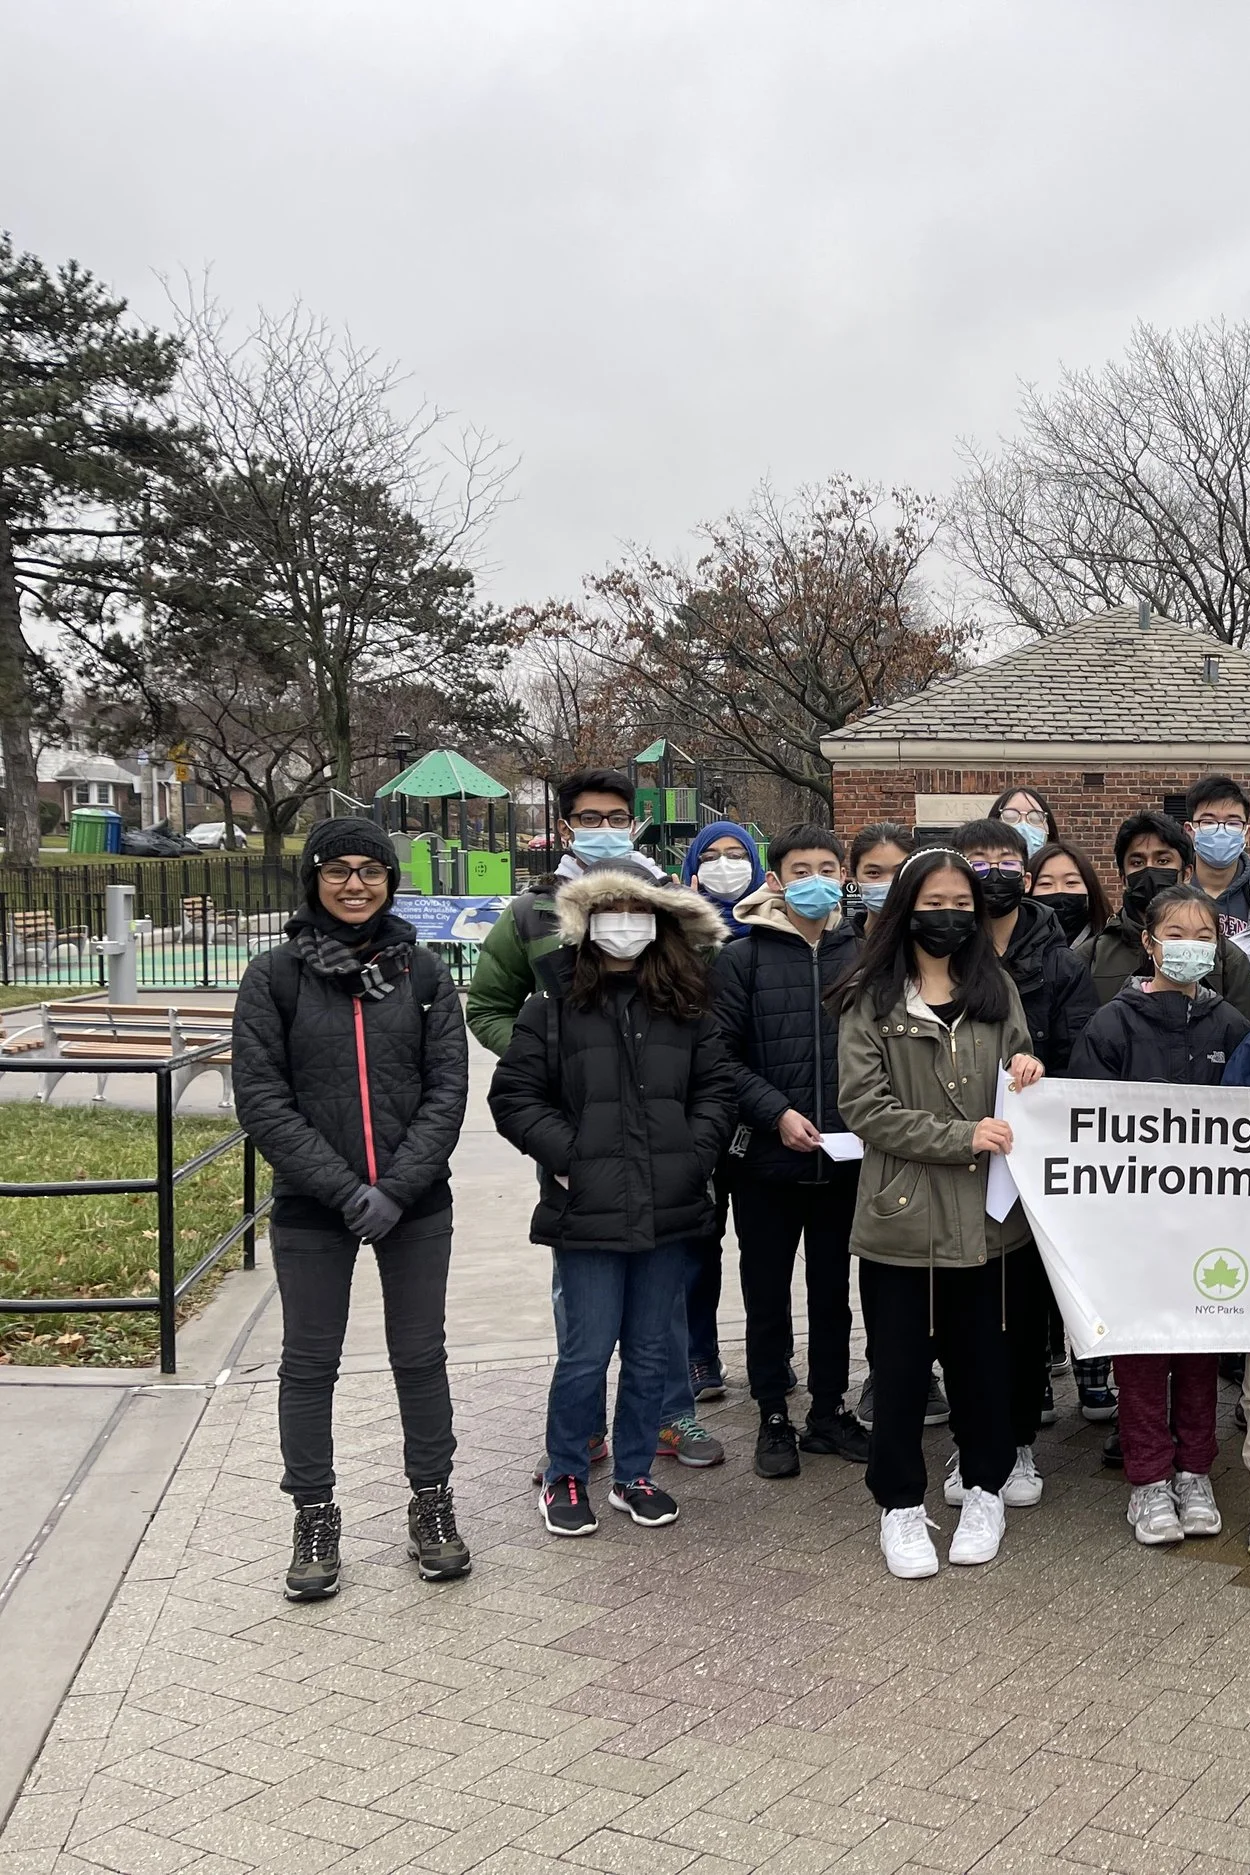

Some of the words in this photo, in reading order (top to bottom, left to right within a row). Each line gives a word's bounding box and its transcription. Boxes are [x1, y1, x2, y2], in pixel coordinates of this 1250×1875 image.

[945, 802, 985, 817] MEN
[414, 899, 451, 907] COVID-19
[436, 913, 451, 921] City
[1194, 1305, 1215, 1314] NYC
[1217, 1305, 1245, 1315] Parks
